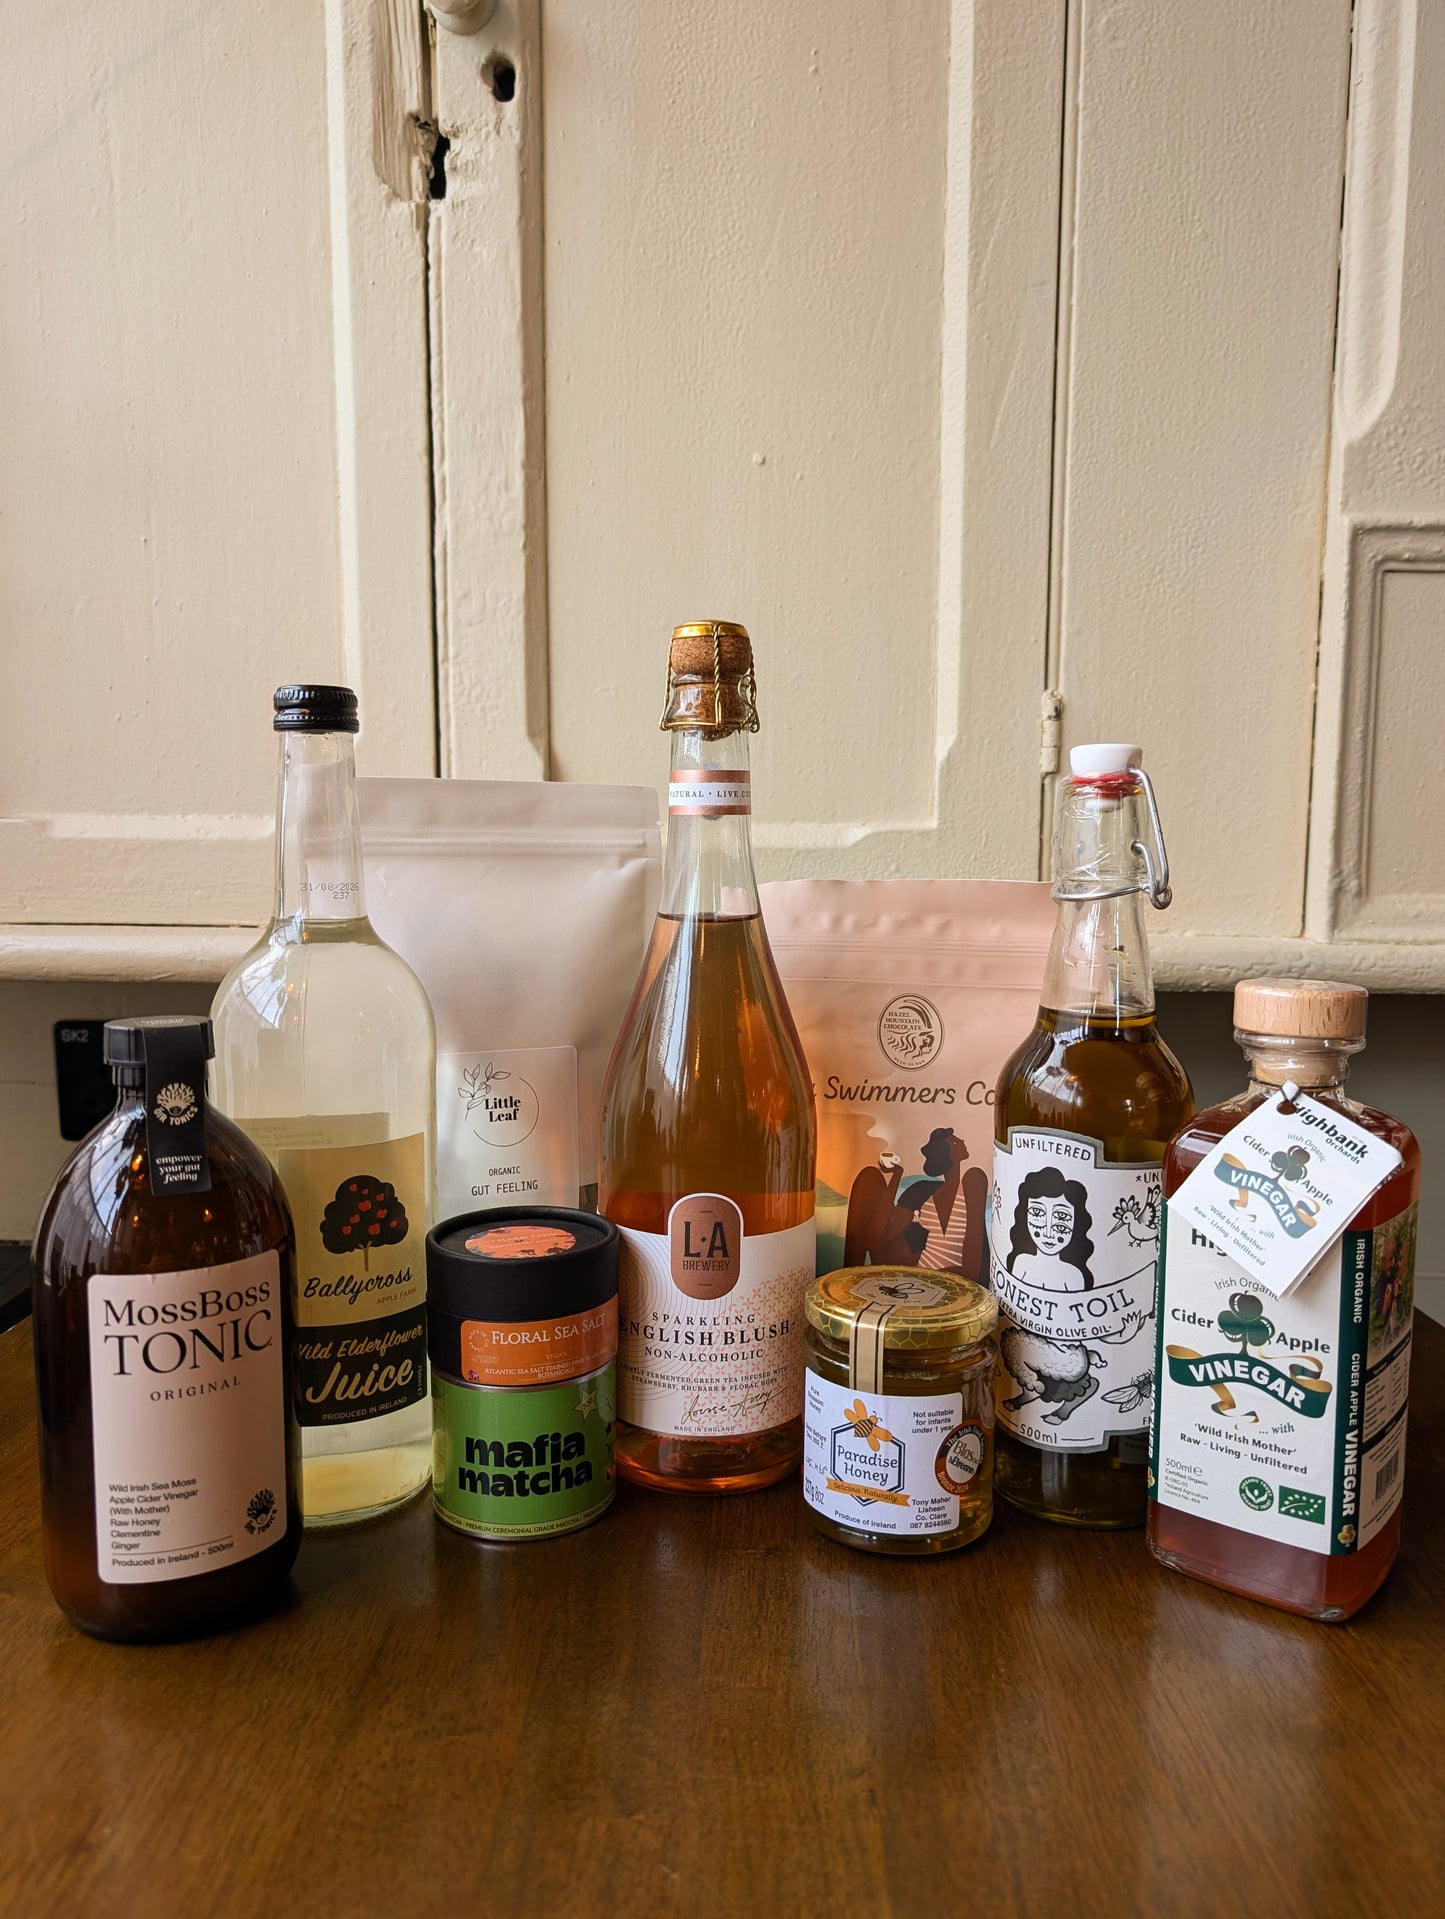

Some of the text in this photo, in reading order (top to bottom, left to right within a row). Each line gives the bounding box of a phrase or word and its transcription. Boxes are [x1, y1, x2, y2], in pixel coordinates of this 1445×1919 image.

[716, 790, 739, 798] LIVE
[333, 891, 350, 900] 237
[883, 1022, 922, 1031] CHOCOLATE
[885, 1017, 920, 1025] MOUNTAIN
[61, 1028, 90, 1044] SK2
[823, 1075, 956, 1106] Swimmers
[485, 1095, 521, 1110] Little
[169, 1105, 199, 1126] TONICS
[488, 1108, 520, 1123] Leaf
[1014, 1136, 1091, 1161] UNFILTERED
[1242, 1134, 1271, 1157] Cider
[1286, 1132, 1305, 1144] Irish
[1304, 1138, 1327, 1164] Organic
[1324, 1137, 1361, 1165] Orchards
[155, 1155, 202, 1165] empower
[158, 1163, 200, 1176] your gut
[163, 1172, 198, 1185] feeling
[488, 1166, 521, 1177] ORGANIC
[471, 1180, 539, 1197] GUT FEELING
[1300, 1179, 1334, 1207] Apple
[1230, 1169, 1297, 1230] VINEGAR
[1225, 1217, 1241, 1233] Irish
[1258, 1227, 1275, 1240] with
[1192, 1205, 1208, 1219] Raw
[1209, 1219, 1230, 1239] Living
[1232, 1237, 1267, 1267] Unfiltered
[682, 1259, 730, 1271] BREWERY
[303, 1266, 413, 1306] Ballycross
[1214, 1276, 1237, 1290] Irish
[1352, 1238, 1366, 1325] IRISH ORGANIC
[103, 1281, 271, 1327] MossBoss
[376, 1288, 416, 1305] APPLE FARM
[1069, 1288, 1135, 1323] TOIL
[652, 1311, 756, 1326] SPARKLING
[1020, 1315, 1052, 1336] VIRGIN
[1055, 1326, 1088, 1338] OLIVE
[1170, 1307, 1215, 1329] Cider
[491, 1330, 552, 1345] FLORAL
[554, 1325, 580, 1340] SEA
[581, 1312, 607, 1332] SALT
[619, 1317, 790, 1346] ENGLISH BLUSH
[104, 1309, 273, 1376] TONIC
[337, 1324, 424, 1358] Elderflower
[1275, 1331, 1332, 1354] Apple
[645, 1346, 764, 1363] NON-ALCOHOLIC
[484, 1368, 517, 1376] ATLANTIC
[517, 1368, 529, 1376] SEA
[530, 1366, 545, 1375] SALT
[646, 1371, 692, 1384] FERMENTED
[693, 1377, 721, 1385] GREEN
[740, 1370, 771, 1383] INFUSED
[150, 1376, 242, 1402] ORIGINAL
[305, 1358, 414, 1404] Juice
[631, 1375, 680, 1391] STRAWBERRY,
[681, 1385, 720, 1393] RHUBARB
[729, 1382, 759, 1392] FLORAL
[1187, 1358, 1307, 1410] VINEGAR
[322, 1395, 408, 1421] PRODUCED IN IRELAND
[912, 1407, 955, 1419] Not suitable
[674, 1425, 736, 1433] MADE IN ENGLAND
[915, 1416, 952, 1427] for infants
[1271, 1421, 1296, 1435] with
[911, 1424, 956, 1438] under 1 year
[1019, 1423, 1058, 1444] 500ml
[1224, 1427, 1250, 1446] Irish
[1341, 1353, 1361, 1518] CIDER APPLE VINEGAR
[465, 1431, 586, 1468] mafia
[836, 1444, 898, 1470] Paradise
[953, 1440, 974, 1463] Blas
[1179, 1432, 1308, 1476] Raw Living Unfiltered
[458, 1460, 593, 1498] matcha
[843, 1461, 889, 1487] Honey
[937, 1470, 955, 1493] Bronze
[109, 1478, 198, 1493] Wild Irish Sea Moss
[109, 1489, 199, 1505] Apple Cider Vinegar
[912, 1496, 951, 1507] Tony Maher
[110, 1504, 171, 1516] (With Mother)
[918, 1505, 946, 1514] Lisheen
[929, 1513, 947, 1521] Clare
[110, 1517, 161, 1528] Raw Honey
[465, 1516, 581, 1534] PREMIUM CEREMONIAL GRADE MATCHA
[834, 1509, 862, 1525] Produce
[870, 1520, 896, 1530] Ireland
[909, 1522, 923, 1530] 087
[111, 1528, 161, 1538] Clementine
[111, 1541, 141, 1551] Ginger
[112, 1540, 234, 1567] Produced in Ireland 500ml
